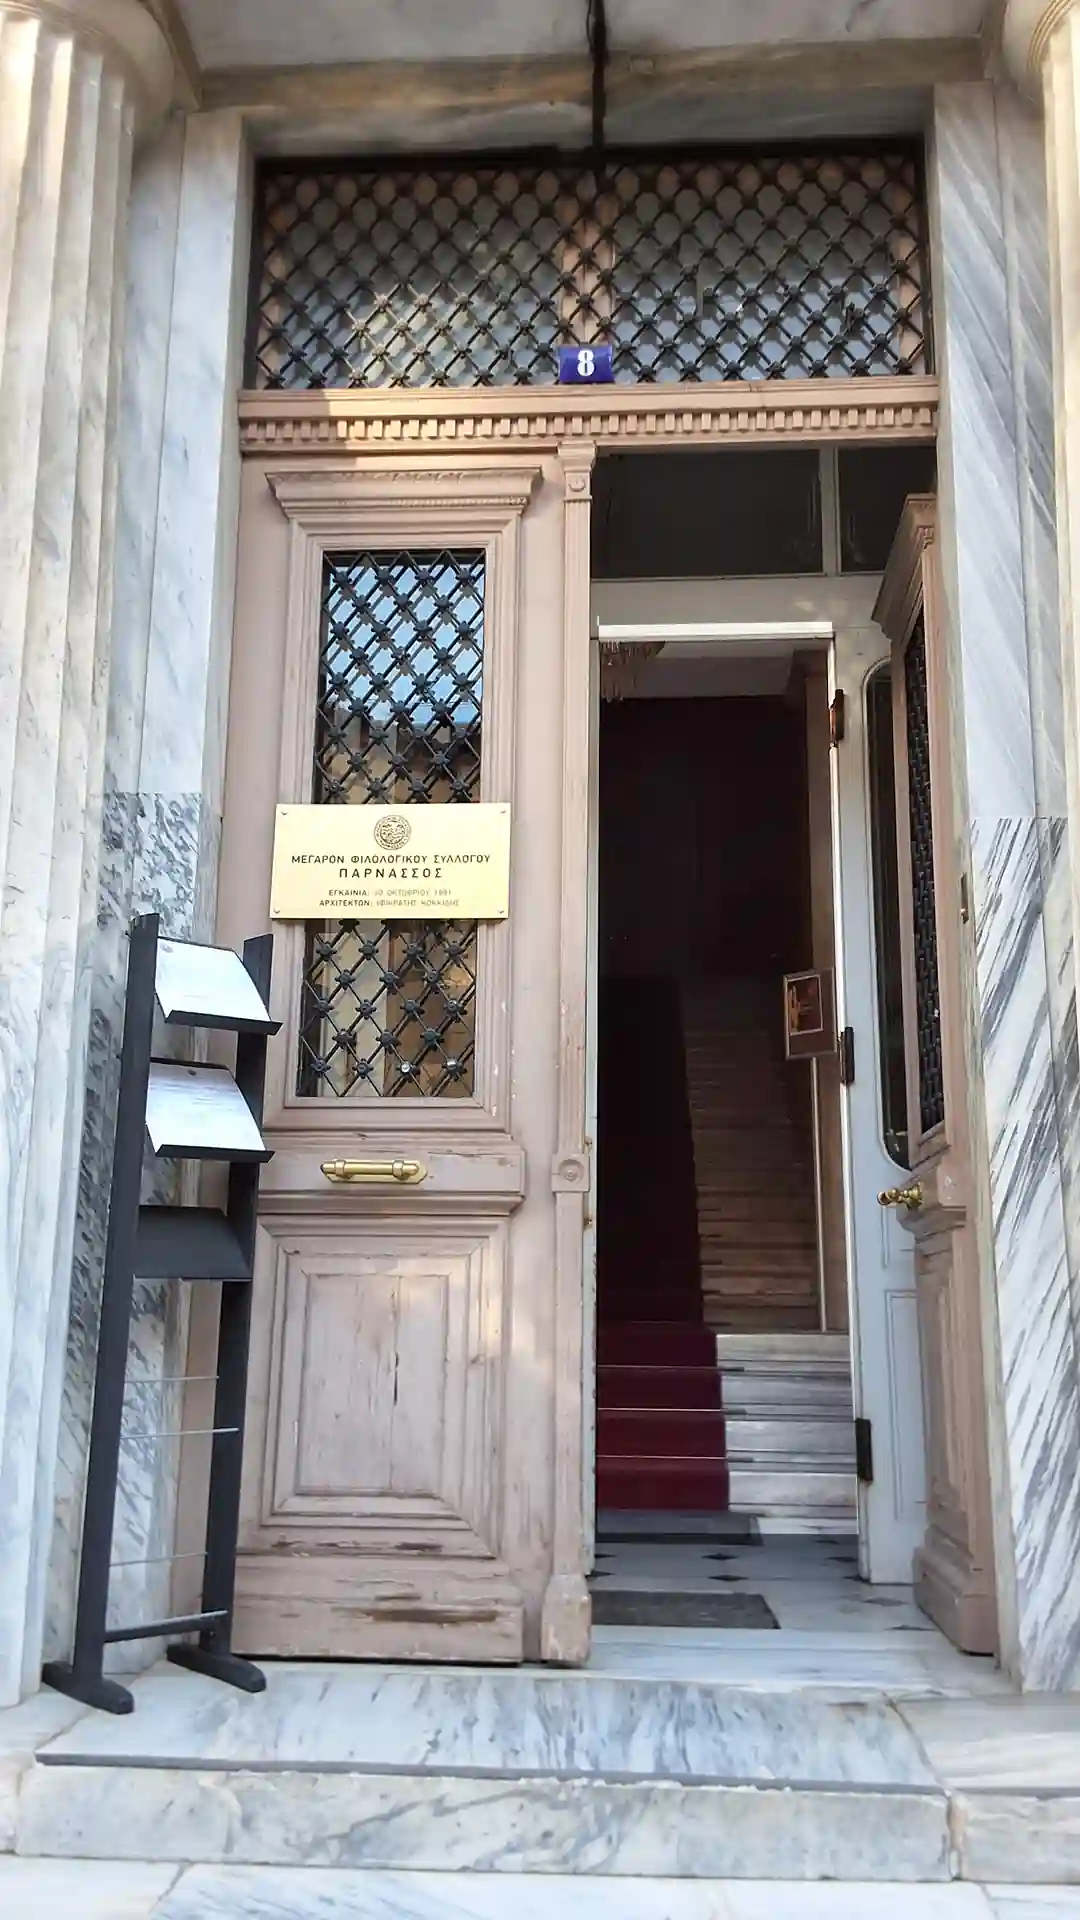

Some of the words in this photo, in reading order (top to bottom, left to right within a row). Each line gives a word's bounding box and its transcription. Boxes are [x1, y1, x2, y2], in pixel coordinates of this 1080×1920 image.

[577, 350, 595, 377] 8
[291, 854, 345, 864] ΜΕΓΑΡΟΝ
[350, 854, 428, 864] ΦΙΛΟΛΟΓΙΚΟΥ
[433, 854, 491, 864] ΣΥΛΛΟΓΟΥ
[338, 867, 443, 879] ΠΑΡΝΑΣΣΟΣ
